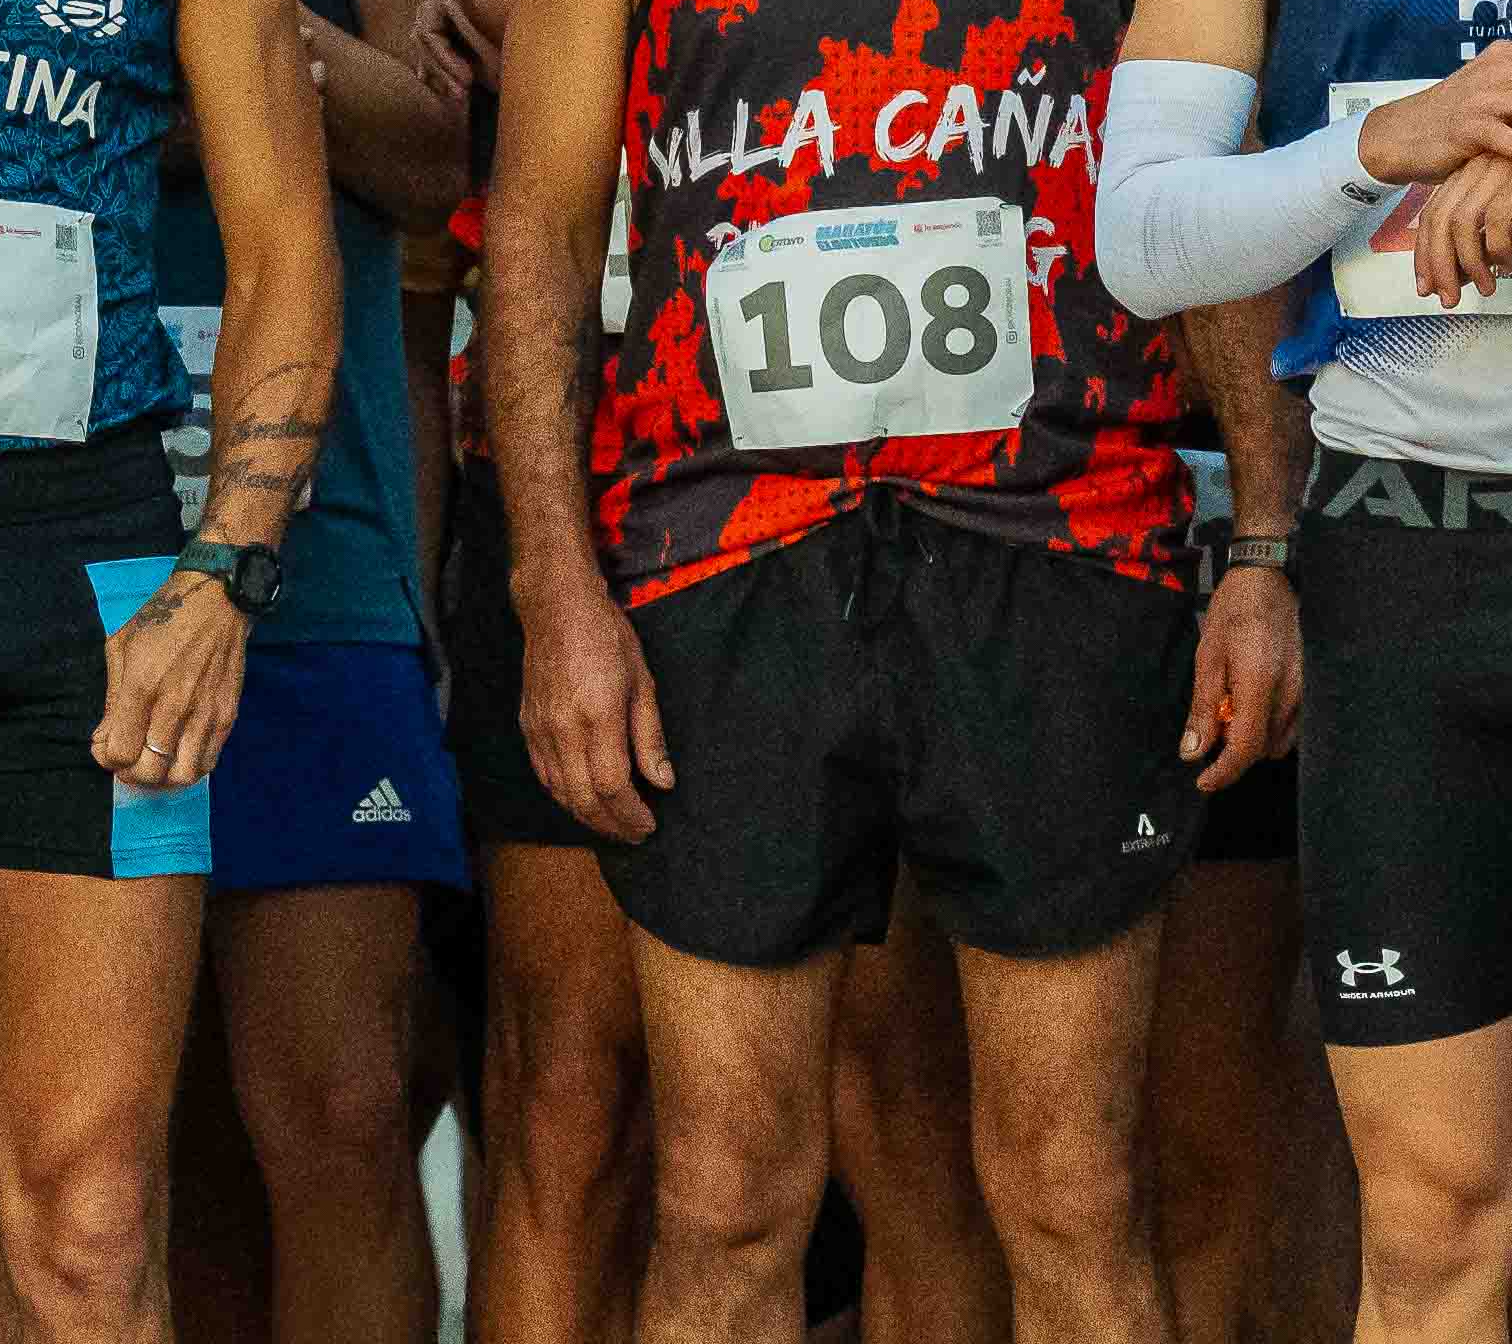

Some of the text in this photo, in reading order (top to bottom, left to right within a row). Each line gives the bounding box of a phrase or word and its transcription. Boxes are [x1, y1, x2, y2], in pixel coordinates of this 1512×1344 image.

[874, 60, 1106, 185] CAÑA
[738, 265, 998, 393] 108
[352, 805, 412, 823] adidas
[1339, 988, 1416, 1000] UNDER ARMOUR
